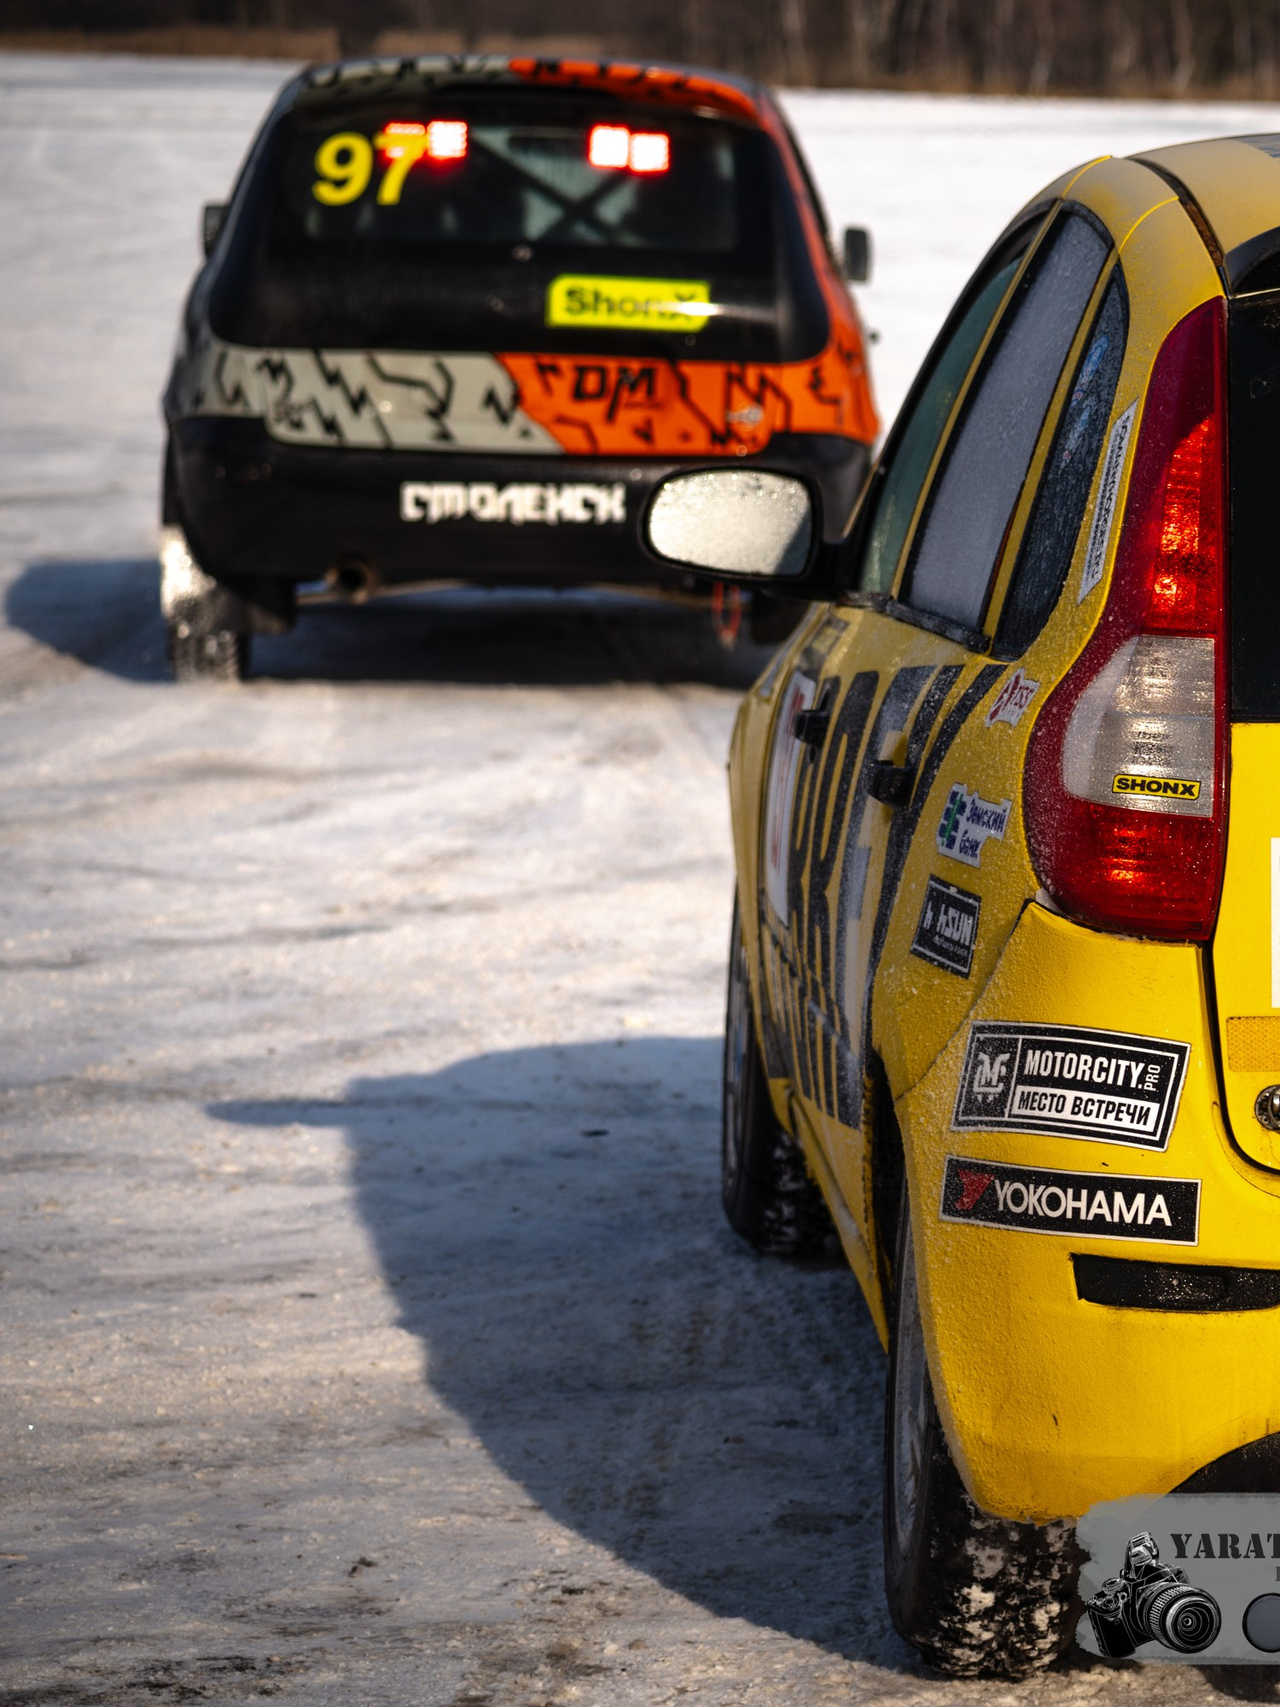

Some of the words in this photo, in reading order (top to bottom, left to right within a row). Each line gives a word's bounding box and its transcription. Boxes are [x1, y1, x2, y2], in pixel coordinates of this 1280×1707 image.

[313, 131, 427, 206] 97
[1116, 777, 1197, 798] SHONX
[1018, 1090, 1065, 1114] МЕСТО
[1072, 1096, 1152, 1127] ВСТРЕЧИ
[995, 1180, 1173, 1228] YOKOHAMA
